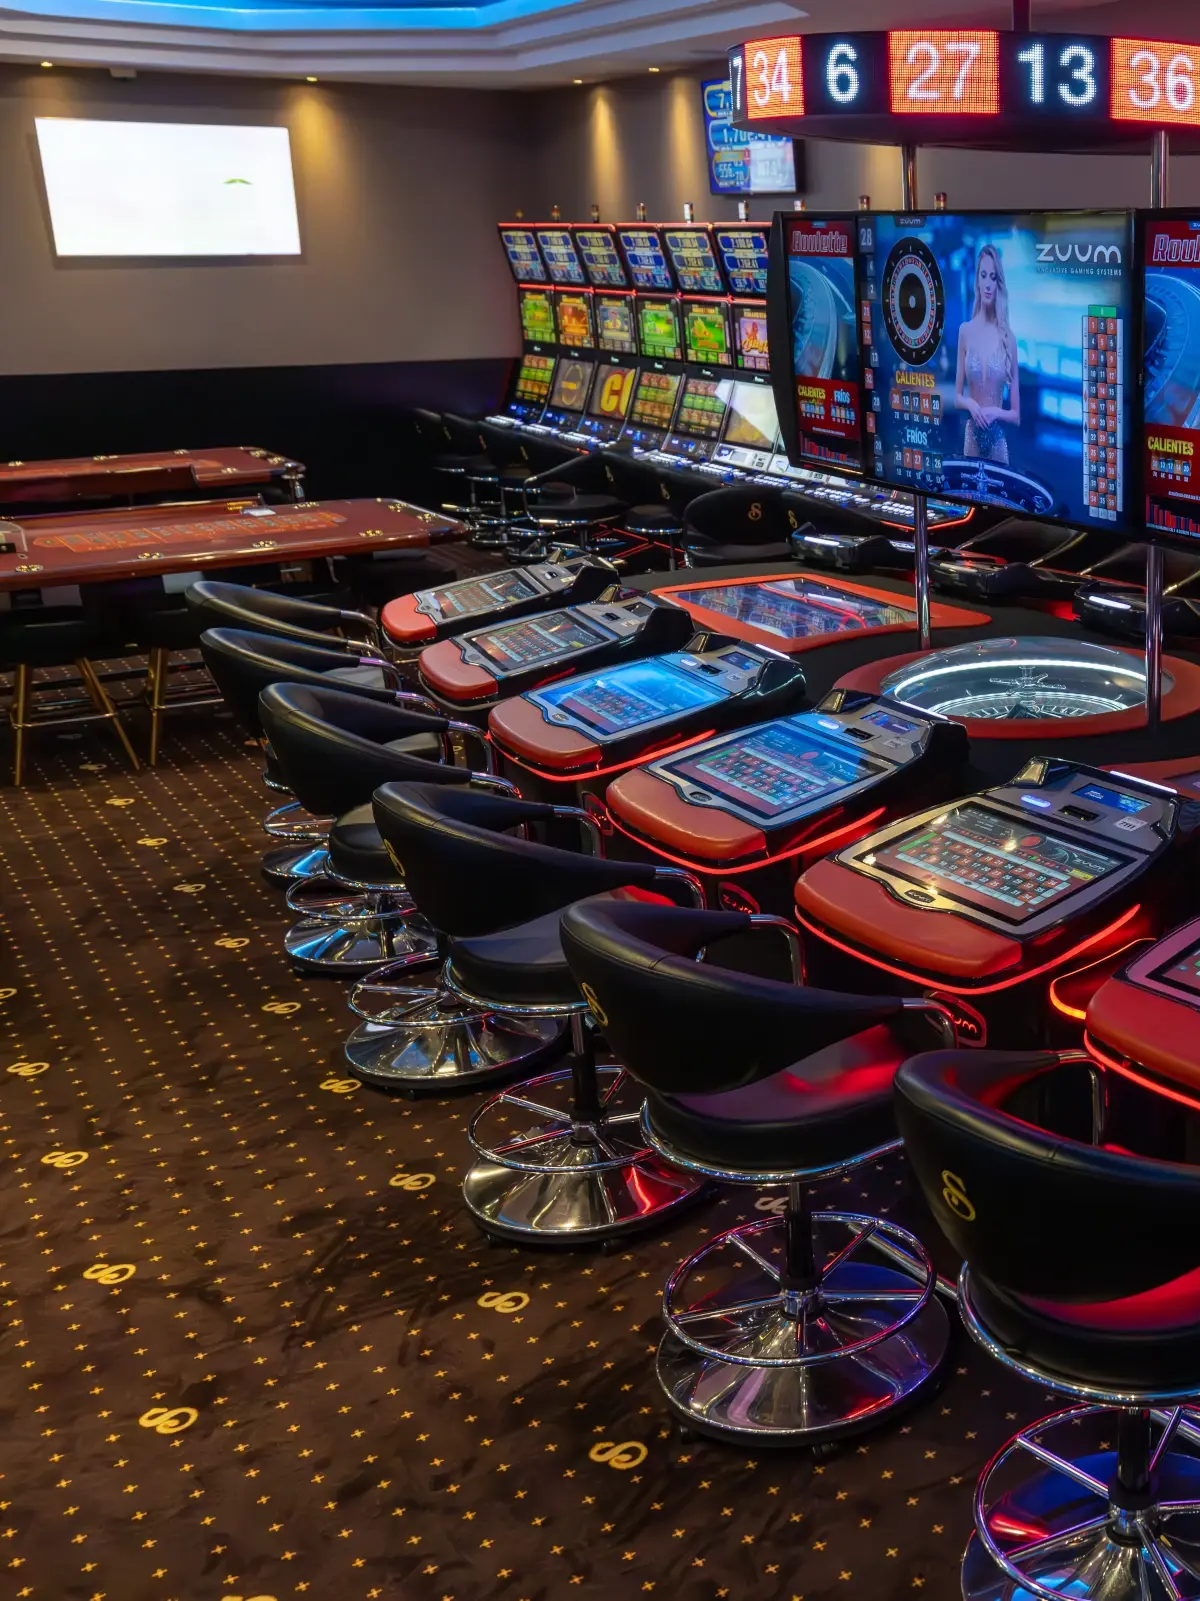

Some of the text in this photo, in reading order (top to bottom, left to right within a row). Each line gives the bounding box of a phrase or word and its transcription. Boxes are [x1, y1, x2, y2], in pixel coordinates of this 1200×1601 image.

[752, 47, 792, 107] 34
[826, 43, 860, 103] 6
[906, 41, 981, 101] 27
[1018, 43, 1097, 106] 13
[1128, 48, 1195, 111] 36
[792, 230, 848, 253] Roulette
[860, 228, 873, 246] 28
[1035, 243, 1122, 264] zuum
[1096, 268, 1122, 276] SYSTEMS
[895, 370, 935, 388] CALIENTES
[797, 385, 826, 399] CALIENTES
[902, 395, 909, 405] 13
[912, 397, 919, 407] 17
[922, 398, 929, 408] 14
[932, 399, 939, 410] 20
[906, 426, 928, 446] FRÍOS
[1147, 436, 1194, 456] CALIENTES
